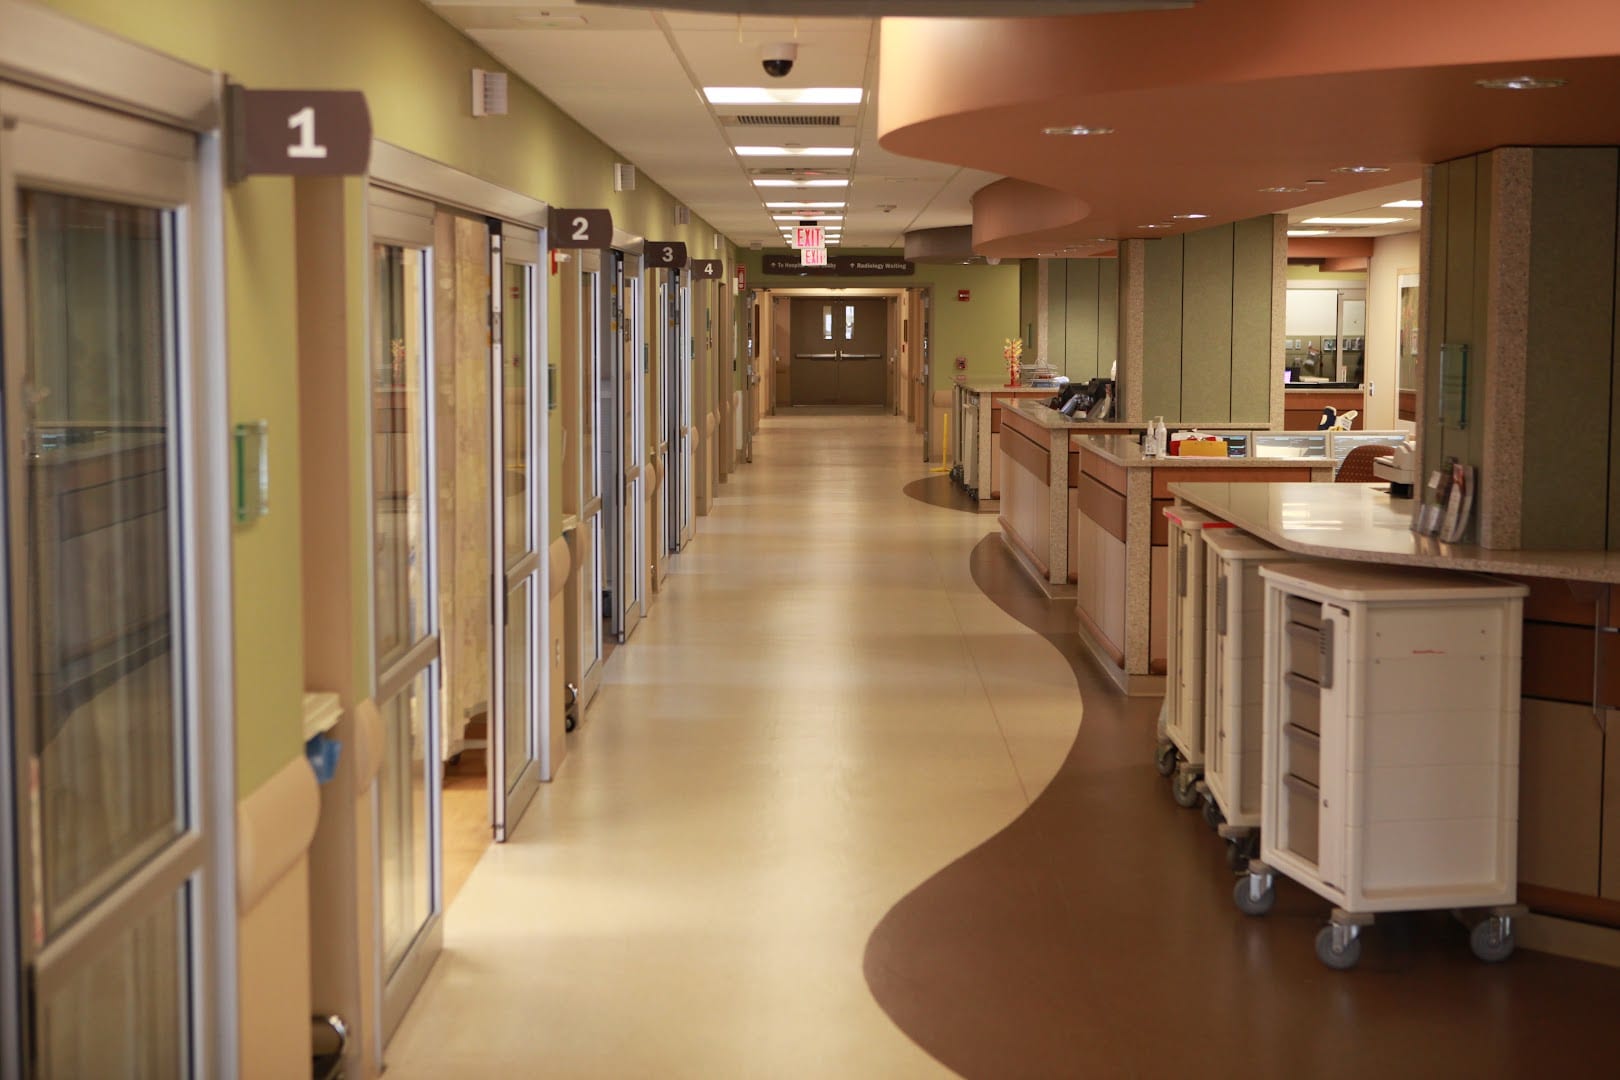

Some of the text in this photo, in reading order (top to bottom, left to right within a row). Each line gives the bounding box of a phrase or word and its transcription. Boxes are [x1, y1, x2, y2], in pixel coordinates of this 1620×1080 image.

[287, 106, 327, 158] 1
[571, 217, 589, 241] 2
[797, 228, 821, 247] EXIT
[662, 247, 674, 262] 3
[805, 249, 823, 265] EXIT
[704, 263, 714, 275] 4
[856, 262, 907, 270] Radiology Waiting
